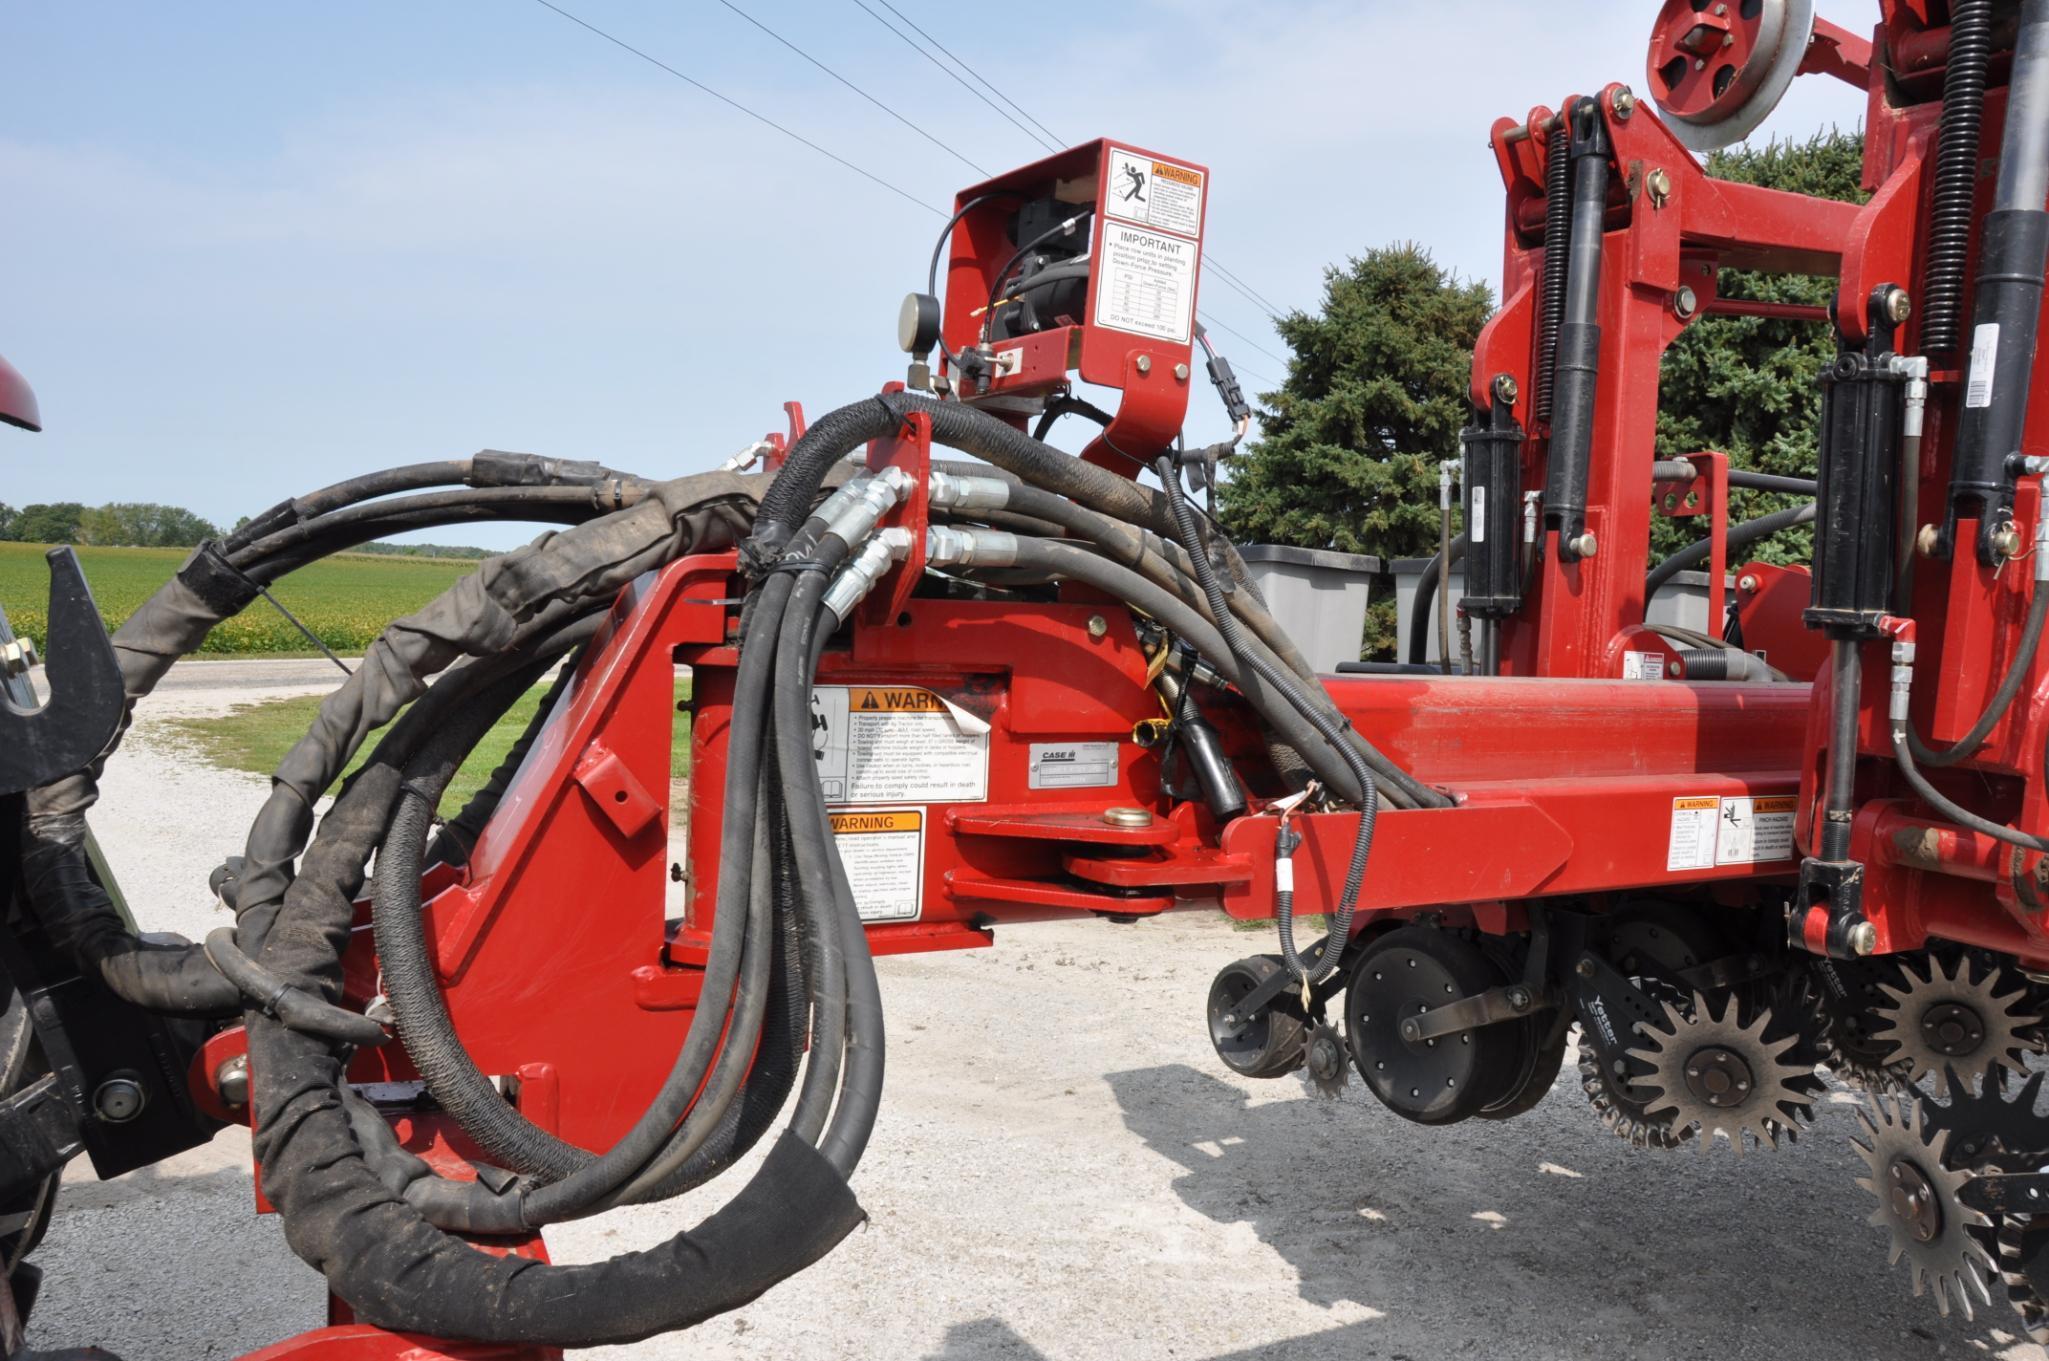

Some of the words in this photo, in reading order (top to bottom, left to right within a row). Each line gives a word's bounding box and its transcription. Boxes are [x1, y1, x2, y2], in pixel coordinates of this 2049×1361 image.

[1163, 164, 1198, 185] WARNING
[1114, 243, 1129, 252] Place
[1121, 231, 1181, 255] IMPORTANT
[1113, 251, 1136, 261] position
[884, 692, 945, 709] WARN
[1042, 751, 1067, 759] CASE
[884, 783, 908, 791] comply
[1595, 994, 1617, 1045] Yetter
